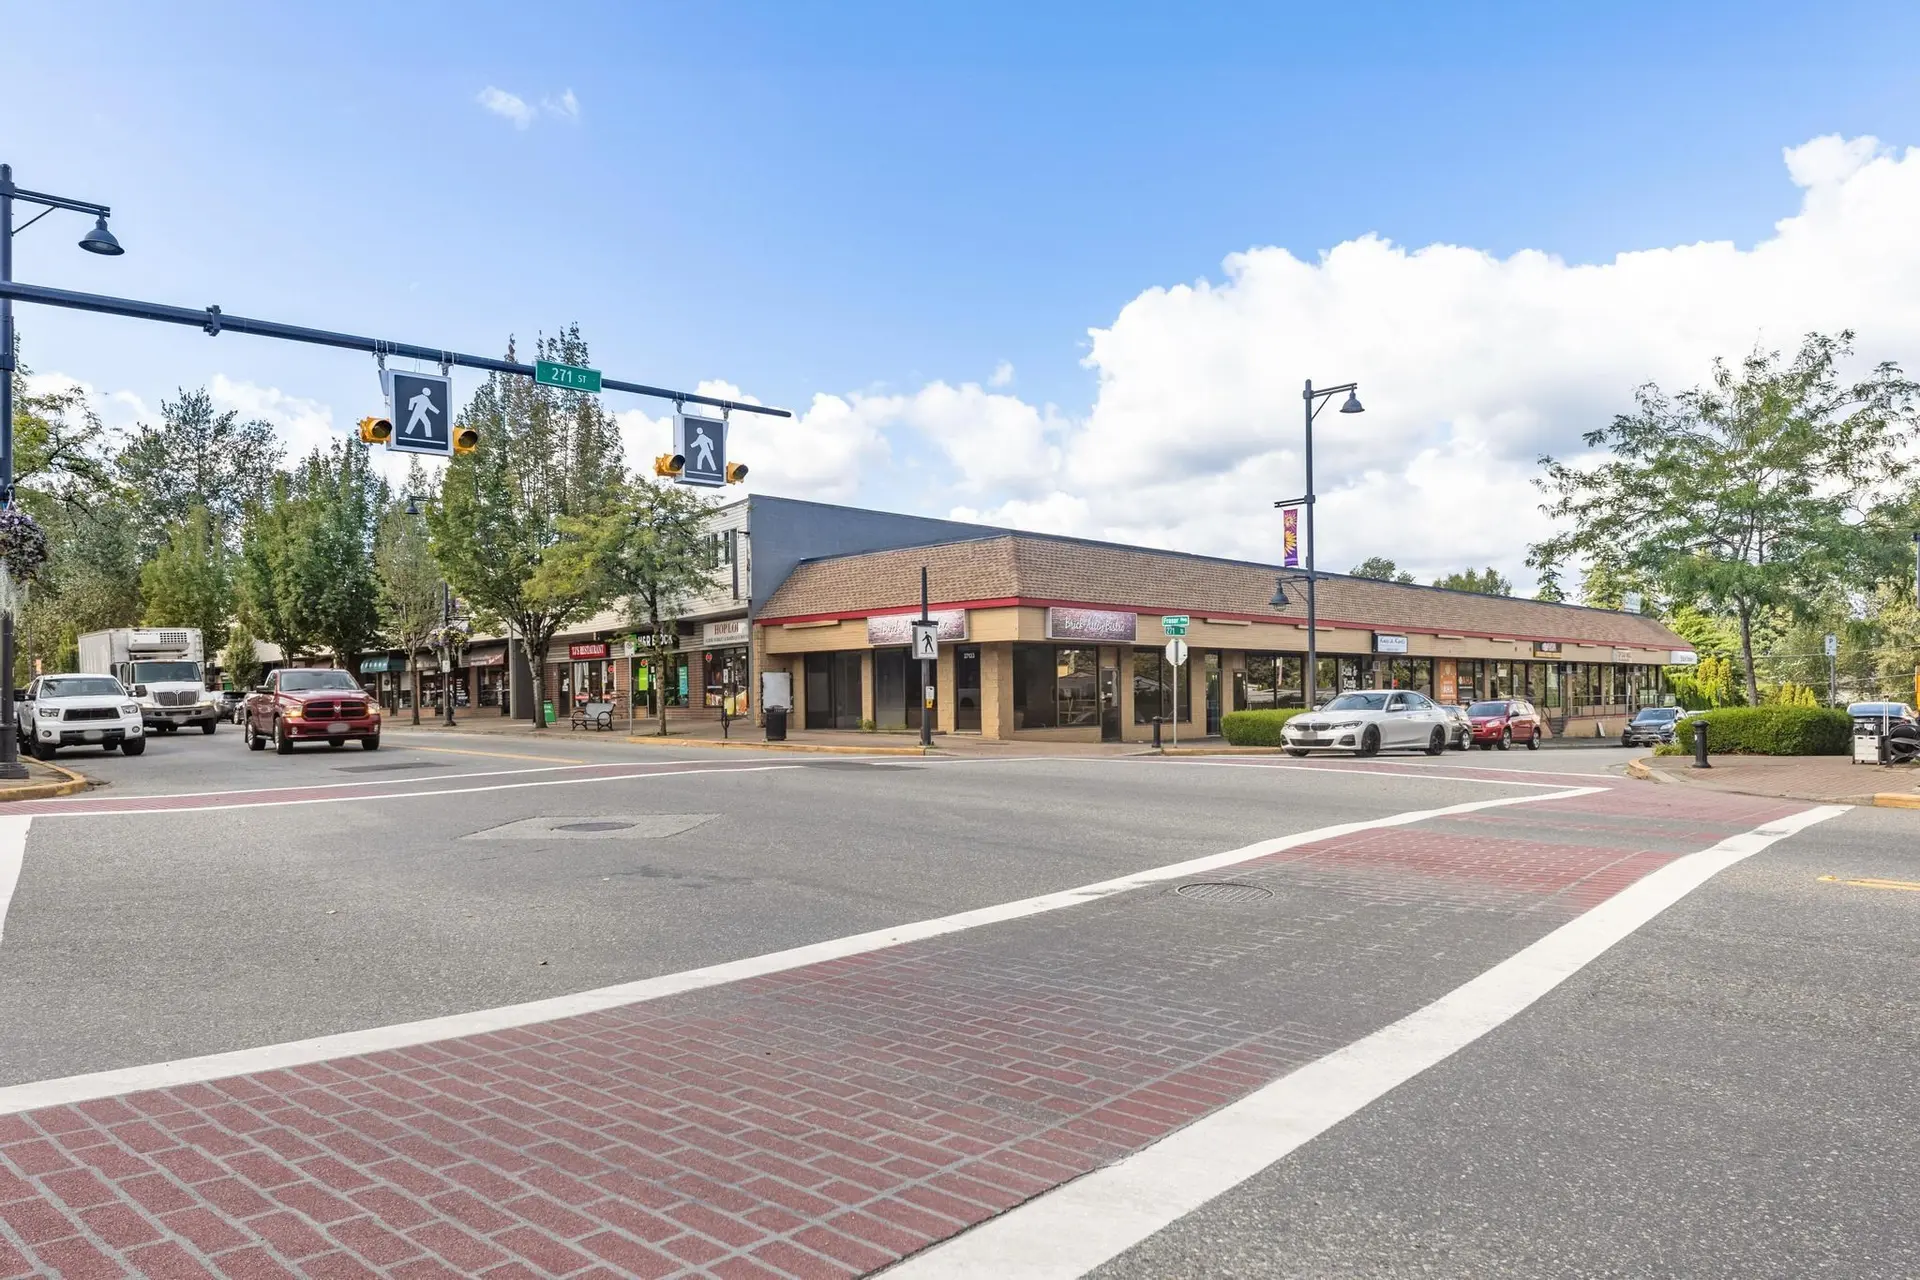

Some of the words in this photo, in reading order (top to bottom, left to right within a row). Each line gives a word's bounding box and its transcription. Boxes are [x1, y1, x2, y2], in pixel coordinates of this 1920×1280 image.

[551, 367, 572, 383] 271
[577, 374, 587, 384] ST
[1064, 616, 1083, 630] Brick
[1166, 627, 1175, 635] 271
[580, 644, 604, 655] RESTAURANT
